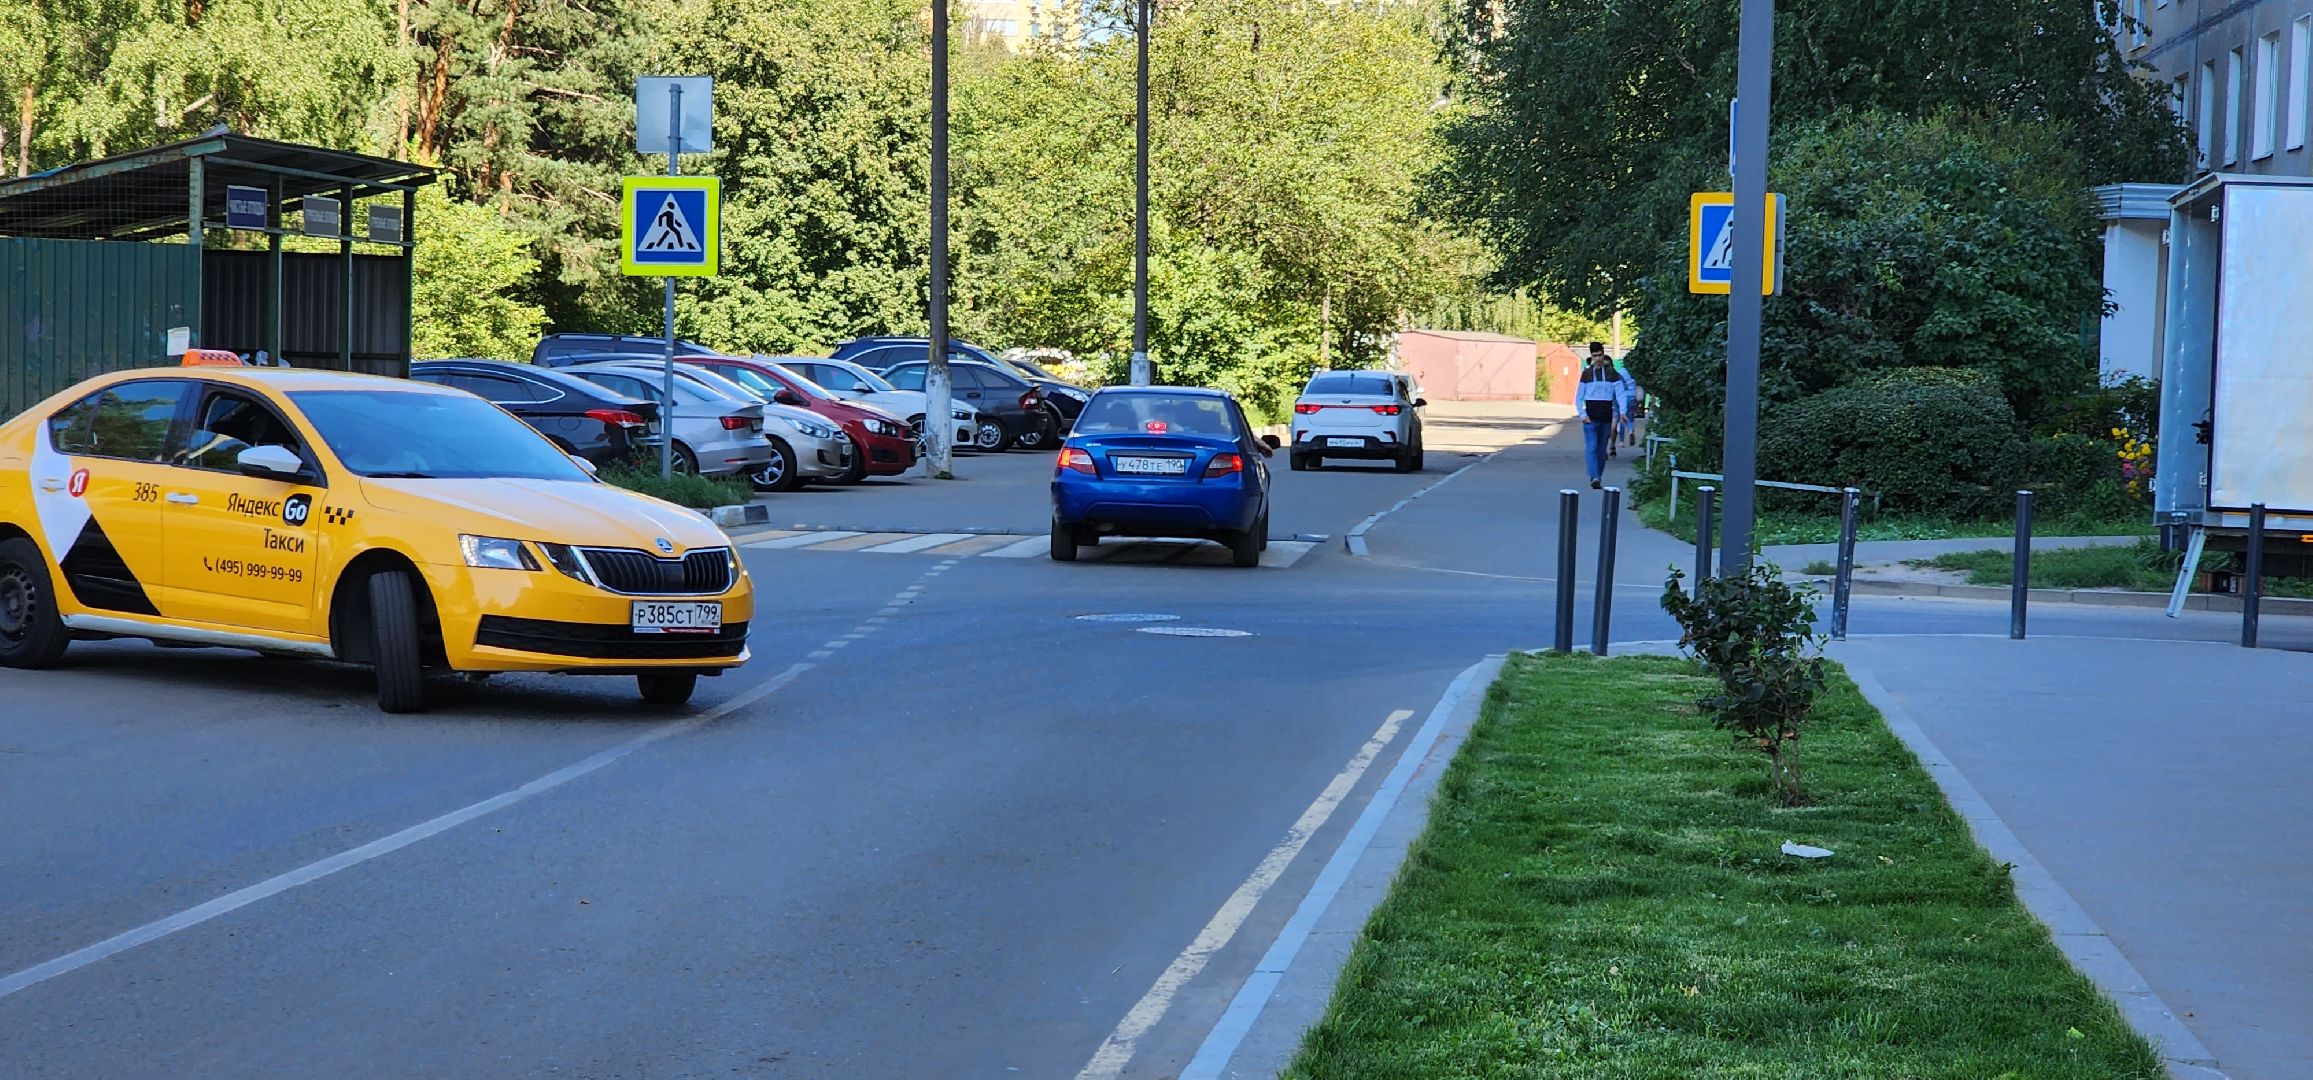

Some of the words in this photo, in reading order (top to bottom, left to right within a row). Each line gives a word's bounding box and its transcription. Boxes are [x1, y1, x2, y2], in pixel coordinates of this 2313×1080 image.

[72, 472, 86, 493] Я
[133, 482, 159, 502] 385
[227, 493, 281, 517] Яндекс
[285, 498, 308, 520] Go
[264, 528, 304, 553] Такси
[216, 558, 243, 577] (495)
[247, 563, 302, 582] 999-99-99
[637, 605, 693, 624] Р385СТ
[697, 605, 717, 619] 799
